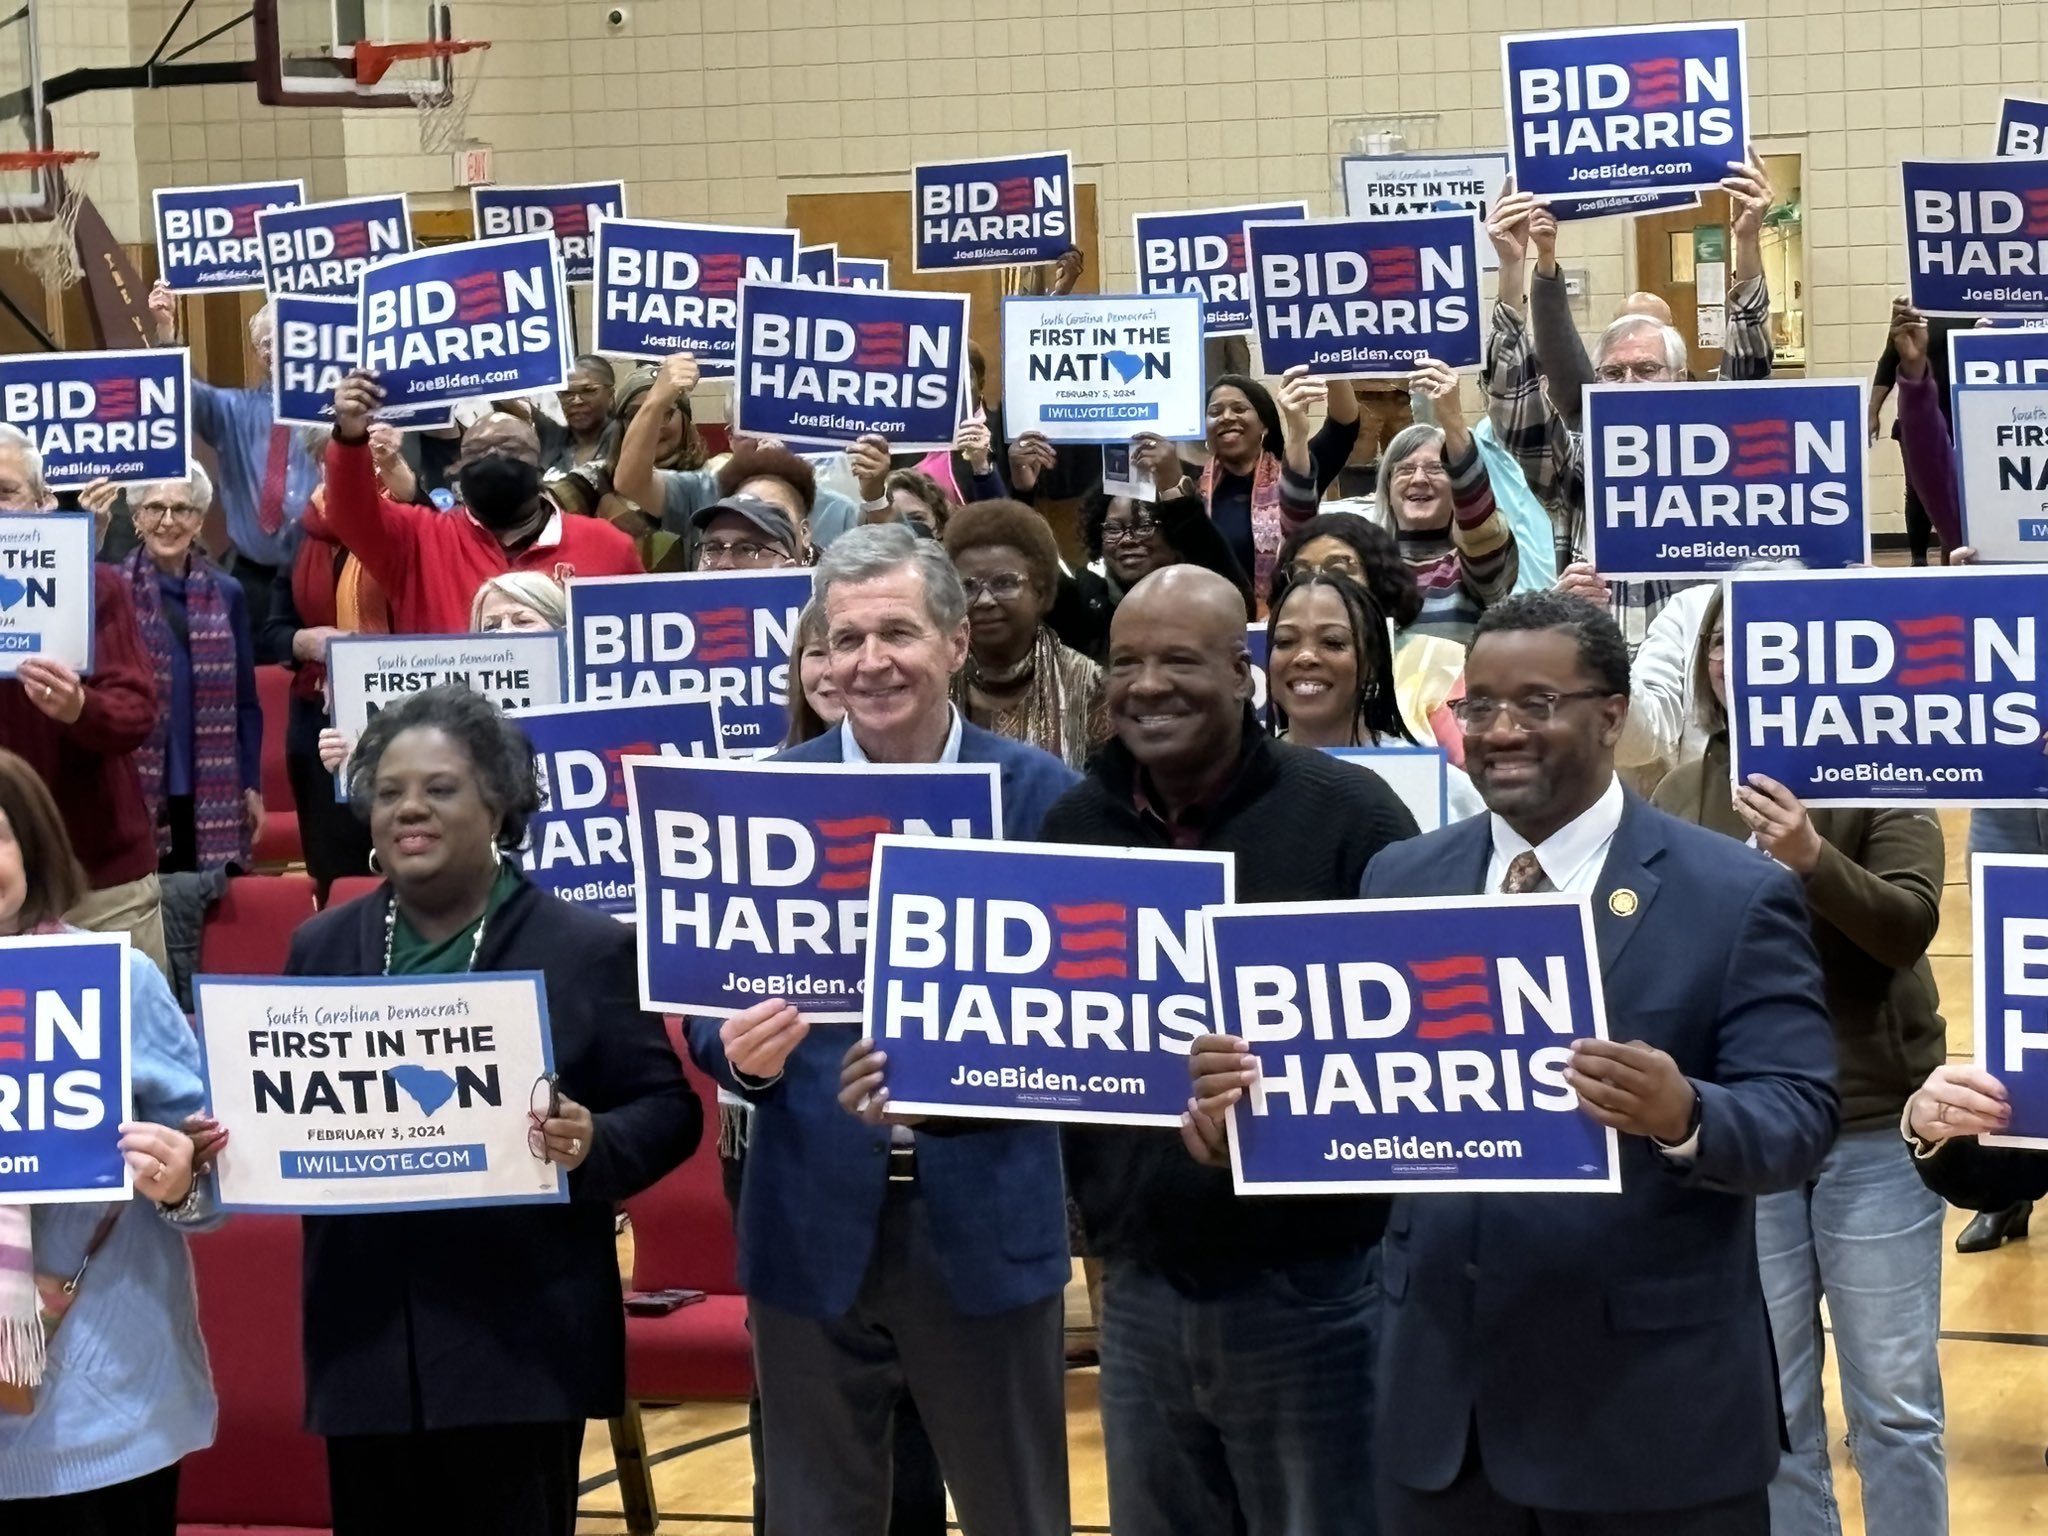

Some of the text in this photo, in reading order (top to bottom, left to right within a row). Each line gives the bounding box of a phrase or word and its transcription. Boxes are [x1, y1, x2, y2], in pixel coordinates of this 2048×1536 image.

[1520, 56, 1729, 114] BIDEN
[1523, 107, 1734, 157] HARRIS
[1368, 180, 1485, 197] FIRST IN THE
[1568, 162, 1692, 181] JoeBiden.com
[923, 175, 1062, 216] BIDEN
[267, 217, 401, 265] BIDEN
[924, 210, 1066, 244] HARRIS
[168, 237, 262, 267] HARR
[1261, 245, 1465, 298] BIDEN
[367, 266, 547, 336] BIDEN
[606, 290, 736, 329] HARR
[1962, 288, 2048, 301] JoeBiden.
[1266, 296, 1470, 339] HARRIS
[366, 315, 551, 371] HARRIS
[752, 313, 950, 369] BIDEN
[1029, 327, 1170, 346] FIRST IN THE
[1310, 347, 1430, 364] JoeBiden.com
[407, 368, 519, 393] JoeBiden.com
[750, 362, 948, 409] HARRIS
[5, 376, 175, 422] BIDEN
[1049, 406, 1149, 419] IWILLVOTE.COM
[789, 411, 906, 433] JoeBiden.com
[1603, 418, 1847, 478] BIDEN
[1605, 482, 1851, 529] HARRIS
[3, 549, 56, 569] THE
[1656, 542, 1801, 559] JoeBiden.com
[584, 606, 799, 665] BIDEN
[1745, 615, 2036, 686] BIDEN
[377, 656, 407, 670] South
[411, 653, 455, 669] Carolina
[364, 671, 436, 693] FIRST
[479, 670, 530, 690] THE
[1748, 691, 2041, 747] HARRIS
[1810, 762, 1984, 784] JoeBiden.com
[889, 893, 1205, 985] BIDEN
[266, 998, 470, 1026] South Carolina Democrats
[1235, 955, 1575, 1042] BIDEN
[886, 979, 1210, 1055] HARRIS
[248, 1025, 496, 1058] FIRST IN THE
[951, 1065, 1146, 1095] JoeBiden.com
[1248, 1046, 1580, 1116] HARRIS
[307, 1128, 385, 1141] FEBRUARY
[408, 1125, 446, 1138] 2024
[1324, 1136, 1523, 1161] JoeBiden.com
[297, 1150, 470, 1173] IWILLVOTE.COM
